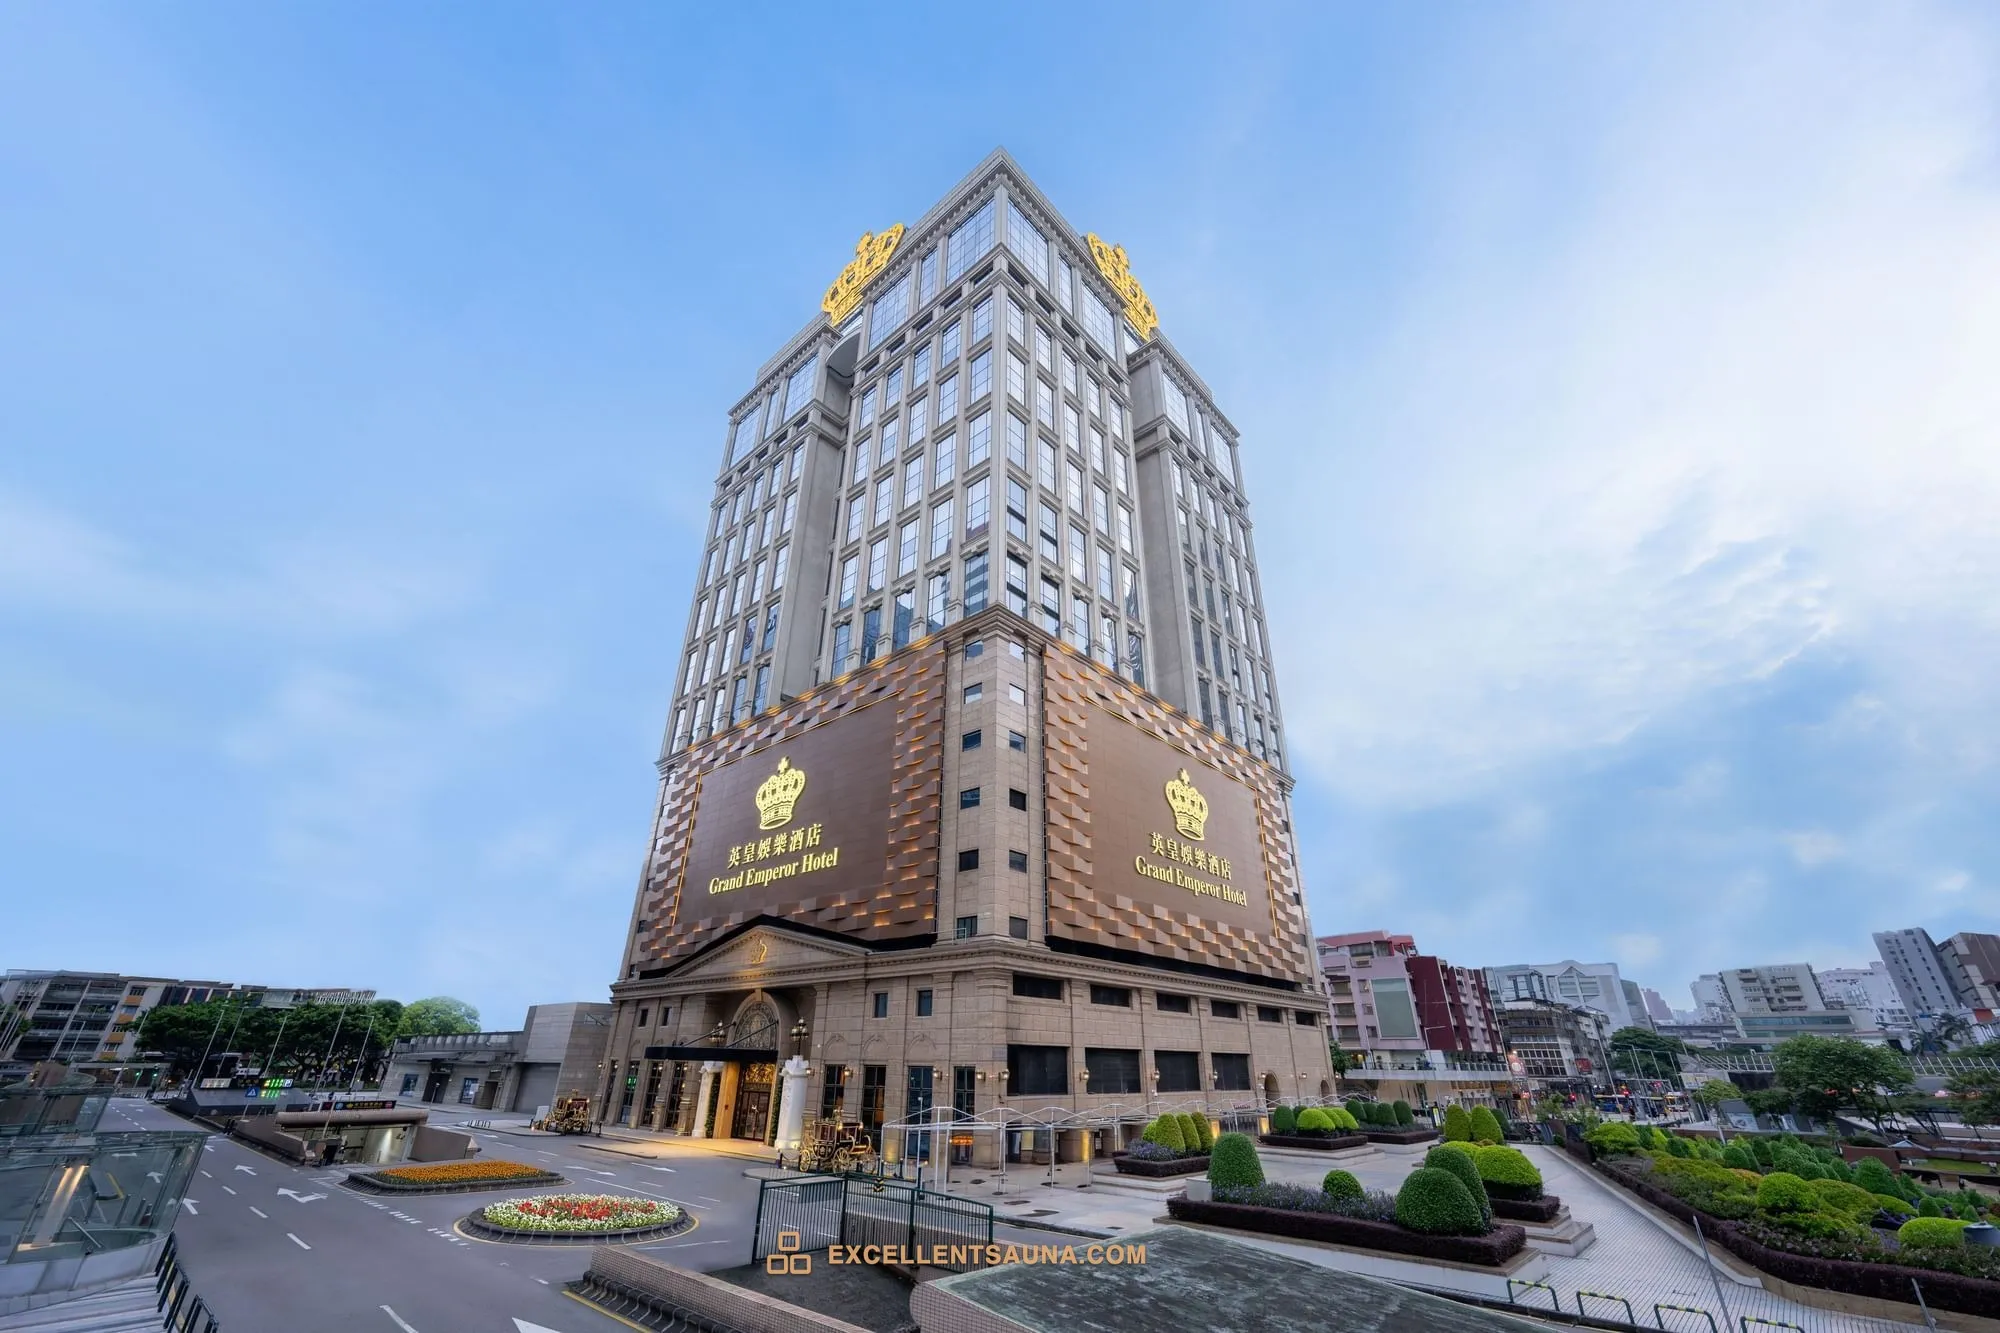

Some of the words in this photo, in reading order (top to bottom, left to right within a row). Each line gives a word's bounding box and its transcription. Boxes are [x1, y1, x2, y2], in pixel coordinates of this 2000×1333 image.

[728, 823, 822, 869] 英皇娛樂酒店
[1151, 831, 1232, 880] 英皇娛樂酒店
[709, 870, 743, 895] Grand
[746, 860, 799, 887] Emperor
[802, 847, 838, 873] Hotel
[1135, 855, 1174, 884] Grand
[1176, 868, 1220, 897] Emperor
[1222, 885, 1247, 907] Hotel
